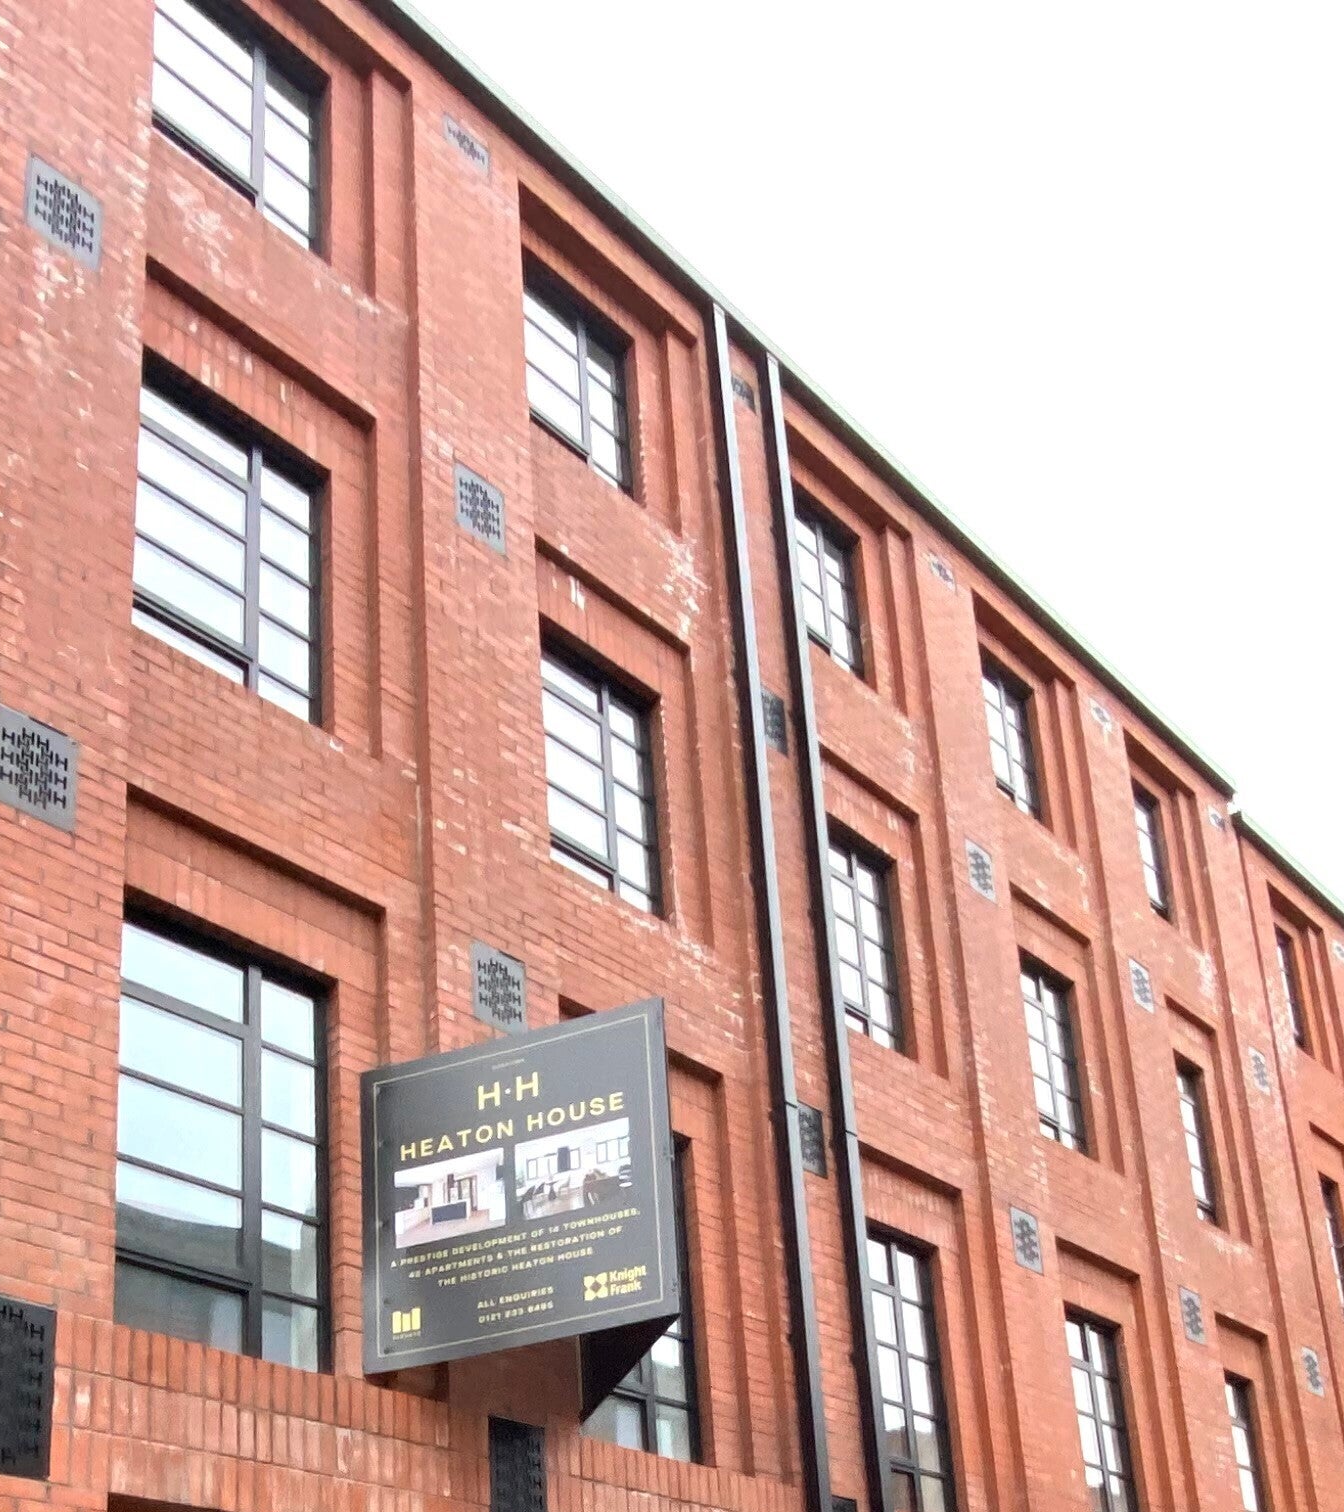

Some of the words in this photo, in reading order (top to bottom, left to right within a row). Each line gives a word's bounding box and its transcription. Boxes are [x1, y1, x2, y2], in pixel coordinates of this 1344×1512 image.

[400, 1118, 514, 1161] HEATON
[527, 1091, 625, 1132] HOUSE
[390, 1260, 397, 1268] A
[399, 1249, 448, 1267] PRESTIGE
[452, 1232, 527, 1255] DEVELOPMENT
[531, 1228, 544, 1238] OF
[425, 1254, 493, 1276] APARTMENTS
[508, 1247, 527, 1257] THE
[530, 1230, 605, 1252] RESTORATION
[608, 1225, 623, 1236] OF
[438, 1276, 456, 1287] THE
[460, 1265, 508, 1283] HISTORIC
[511, 1256, 554, 1271] HEATON
[557, 1246, 593, 1261] HOUSE
[609, 1264, 647, 1282] Knight
[610, 1279, 643, 1296] Frank
[477, 1299, 496, 1309] ALL
[499, 1286, 554, 1305] ENQUIRIES
